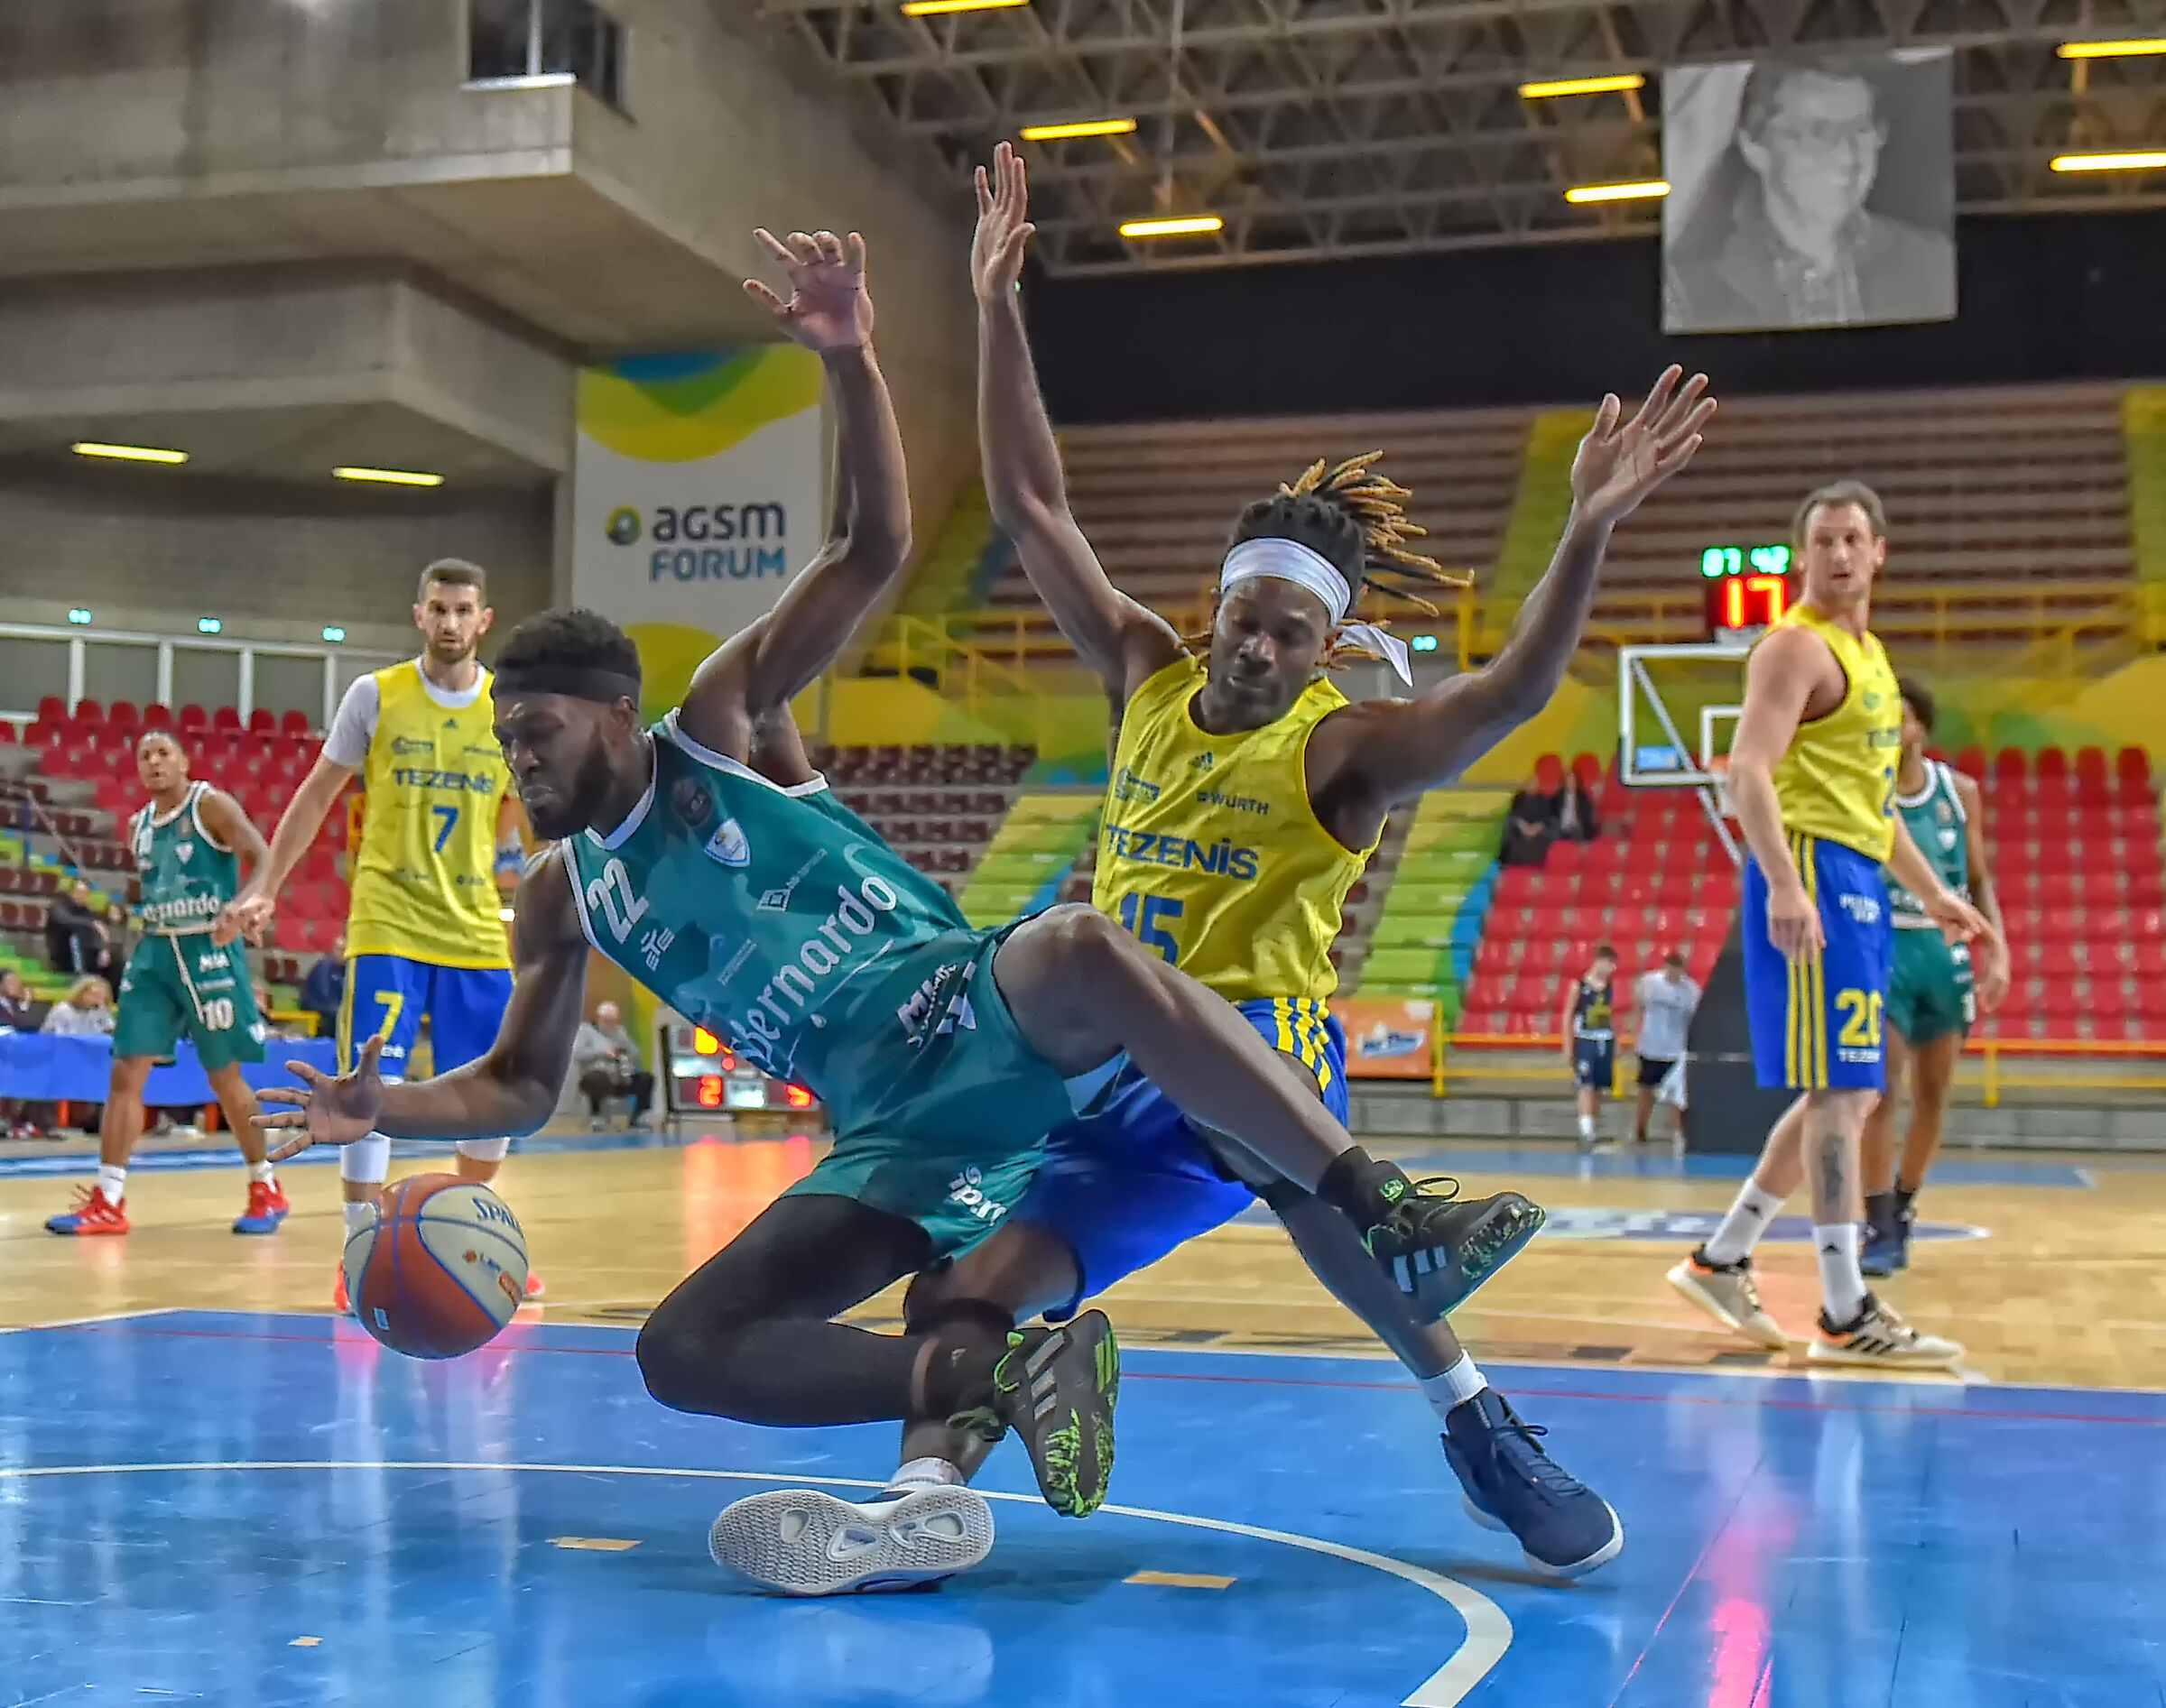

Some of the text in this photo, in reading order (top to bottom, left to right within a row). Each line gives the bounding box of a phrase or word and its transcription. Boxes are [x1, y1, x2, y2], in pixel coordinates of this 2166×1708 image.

[649, 547, 785, 582] FORUM
[1727, 577, 1784, 628] 17
[432, 806, 459, 853] 7
[587, 857, 650, 945] 22
[1120, 891, 1184, 965] 15
[205, 997, 235, 1031] 10
[375, 990, 403, 1044] 7
